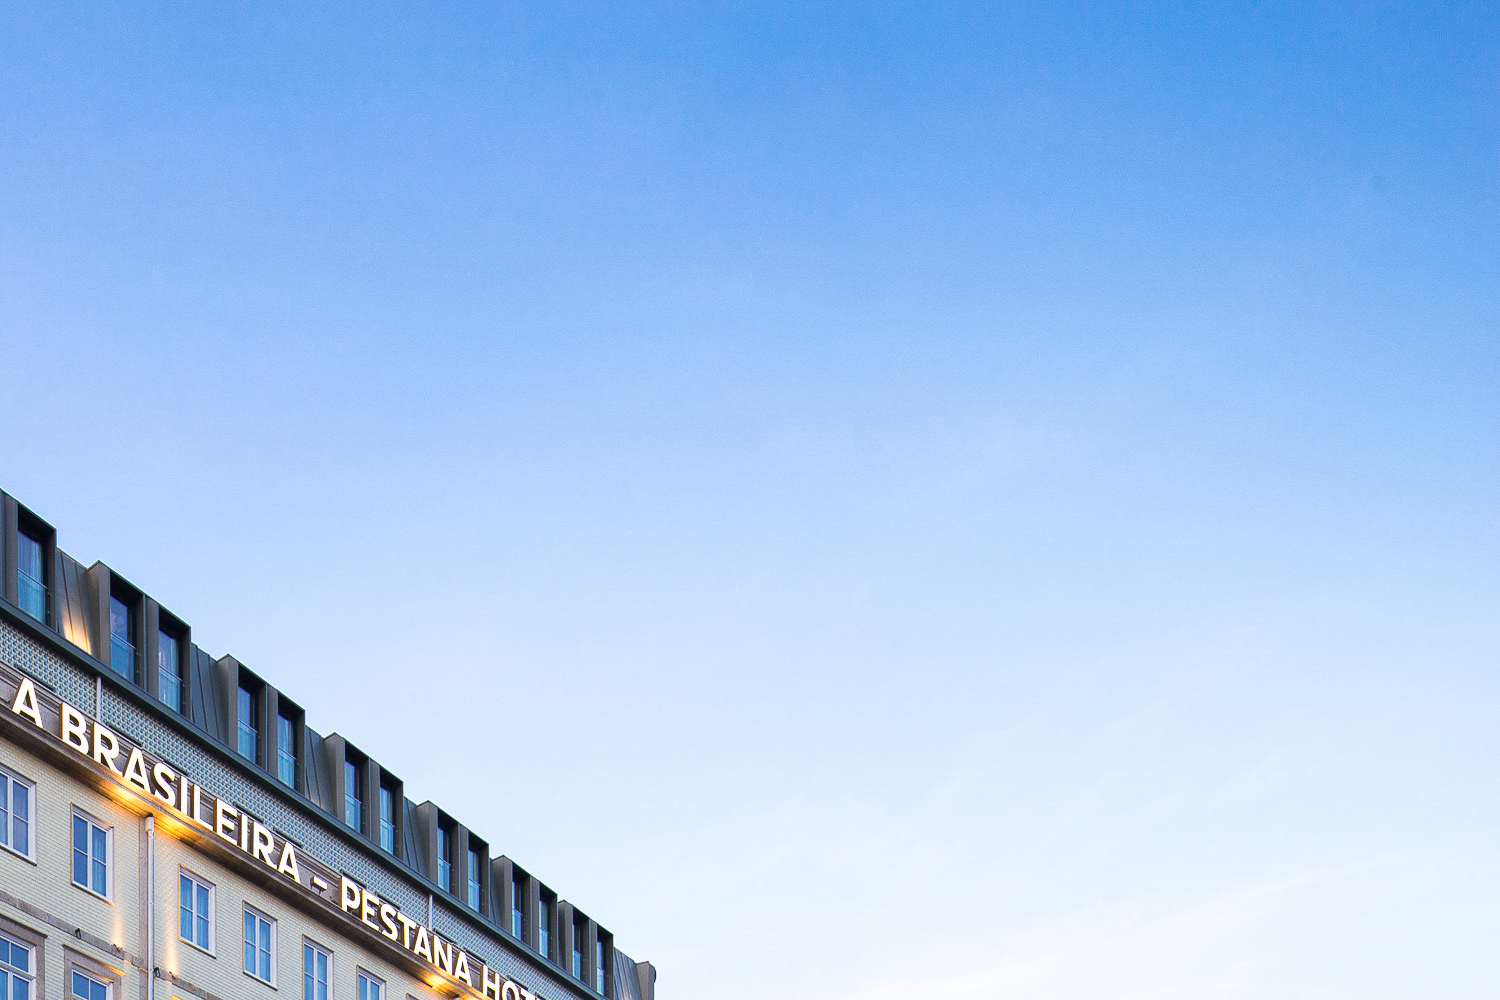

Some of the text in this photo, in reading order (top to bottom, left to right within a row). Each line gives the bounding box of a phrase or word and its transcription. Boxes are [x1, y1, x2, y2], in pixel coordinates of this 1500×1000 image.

[12, 677, 43, 728] A
[60, 702, 301, 882] BRASILEIRA
[339, 876, 472, 987] PESTANA
